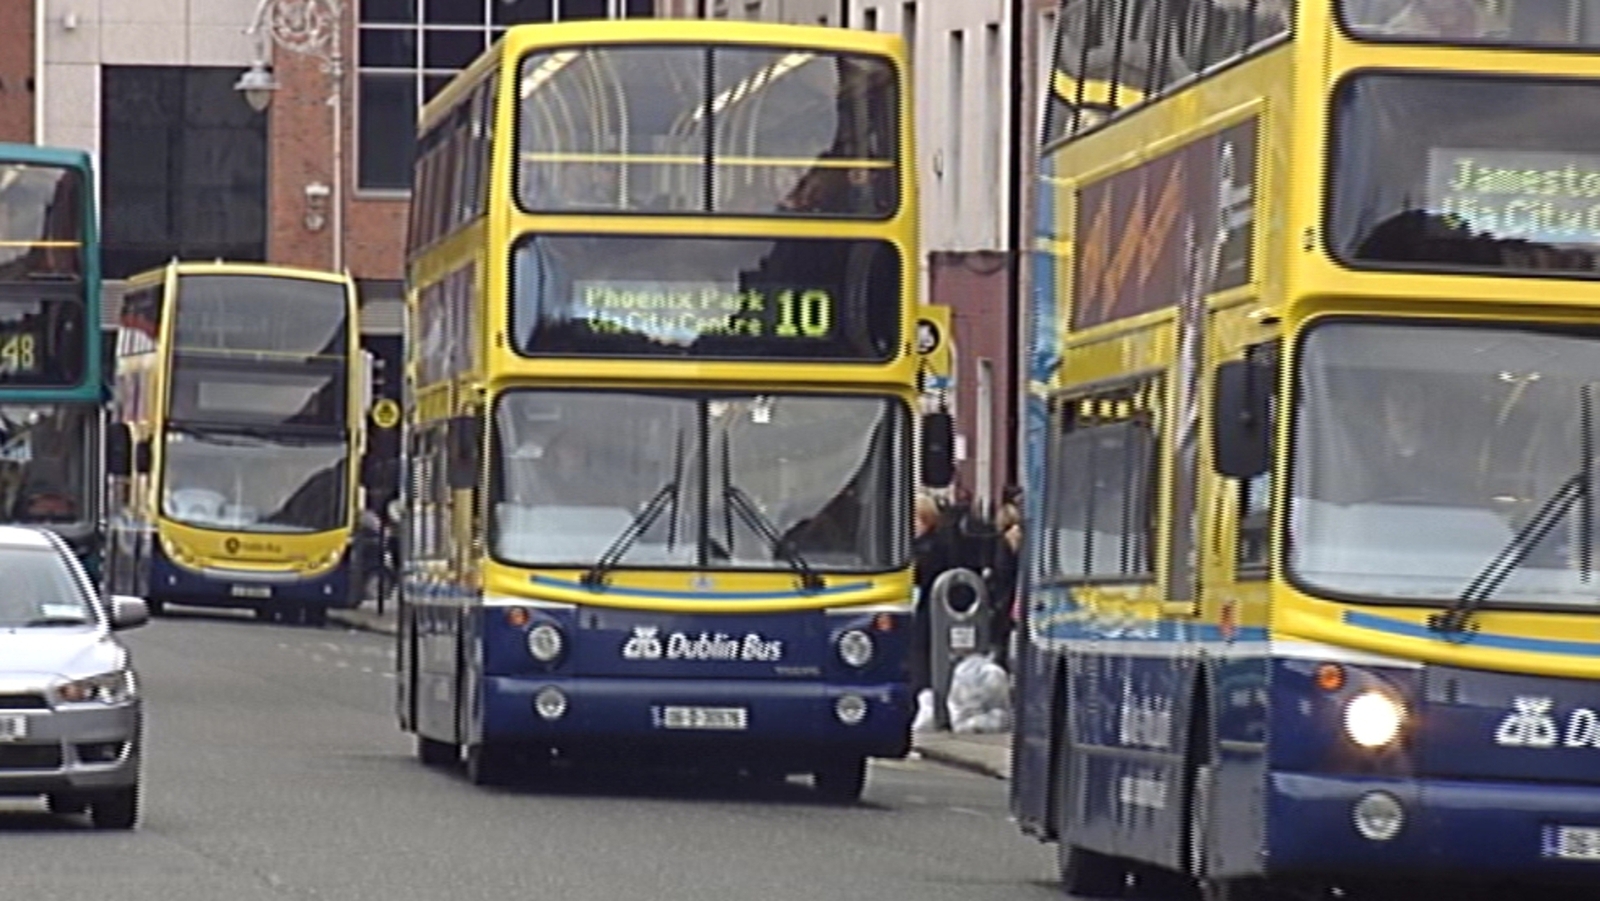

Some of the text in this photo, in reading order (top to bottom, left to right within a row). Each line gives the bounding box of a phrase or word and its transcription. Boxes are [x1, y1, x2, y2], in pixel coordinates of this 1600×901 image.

[586, 287, 764, 311] Phoenix Park
[625, 311, 676, 334] City
[679, 313, 763, 336] Centre
[775, 290, 829, 337] 10
[667, 632, 782, 661] Dublin Bus
